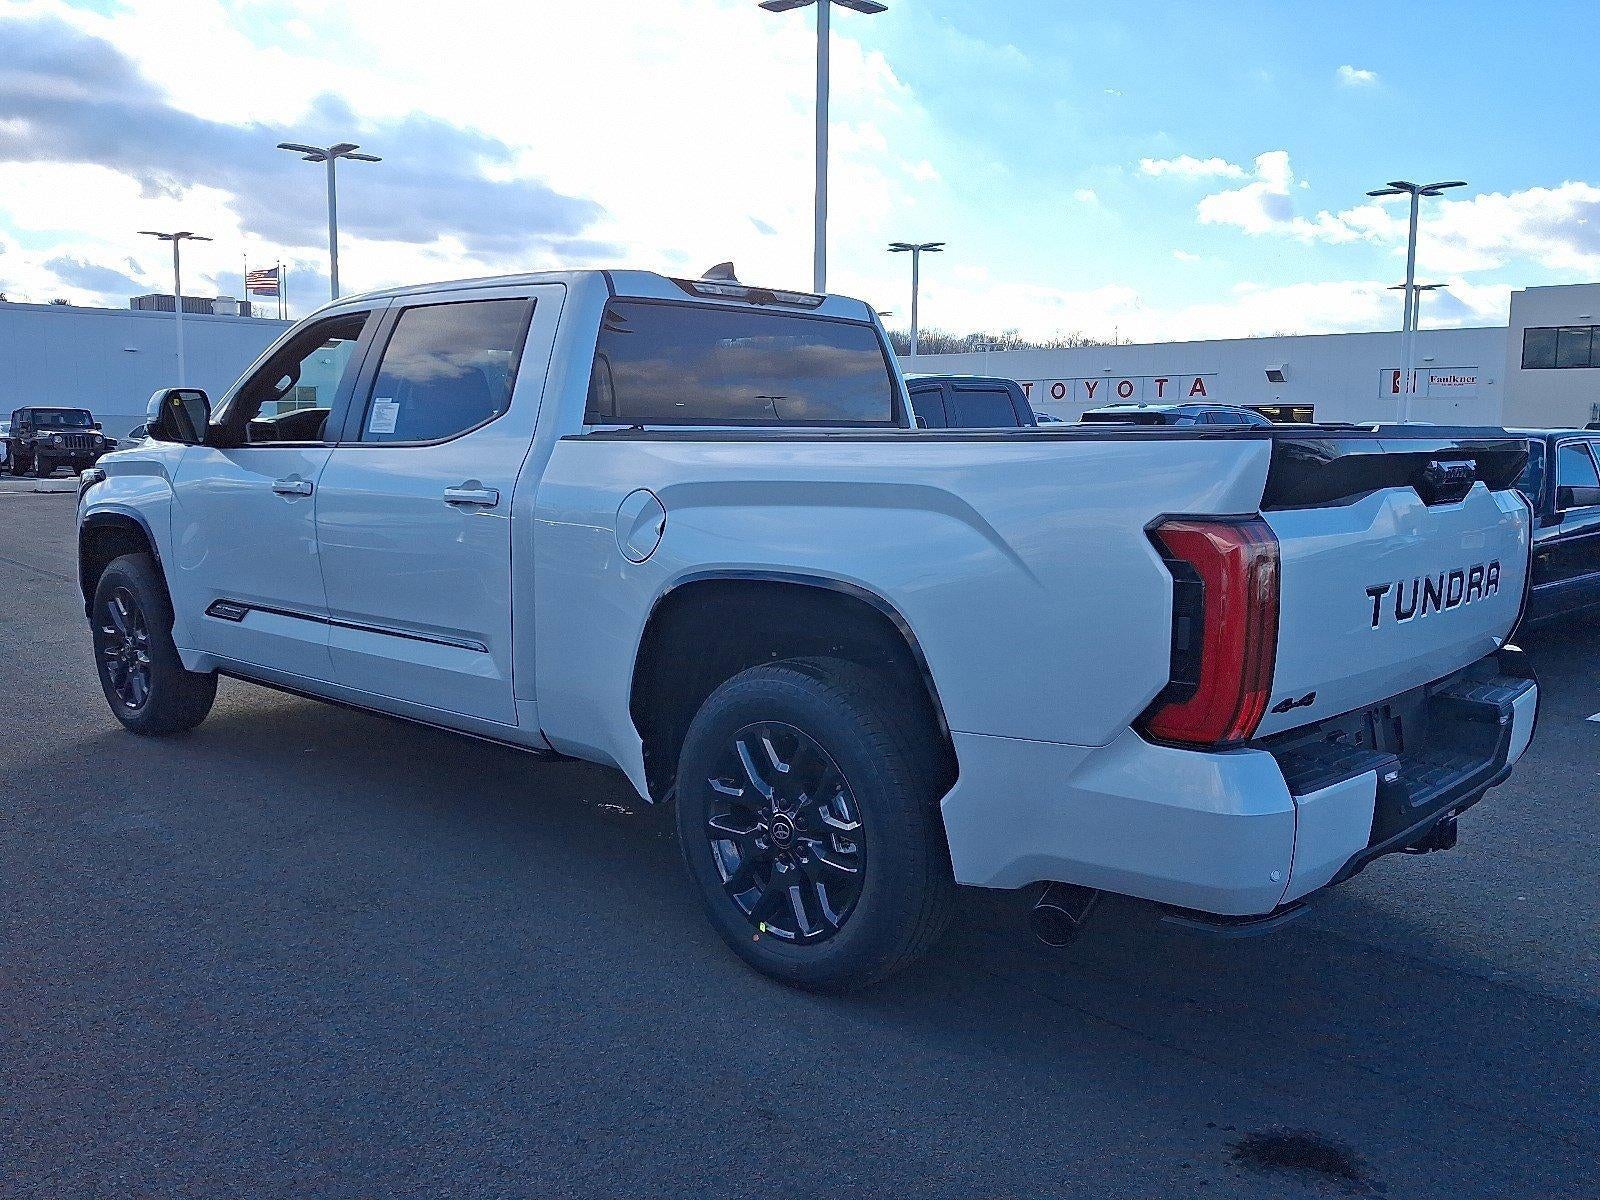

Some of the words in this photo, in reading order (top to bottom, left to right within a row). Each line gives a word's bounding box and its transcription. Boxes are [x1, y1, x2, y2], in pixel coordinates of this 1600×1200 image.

[1022, 377, 1207, 400] TOYOTA
[1430, 375, 1477, 383] Faulkner
[1365, 559, 1501, 630] TUNDRA
